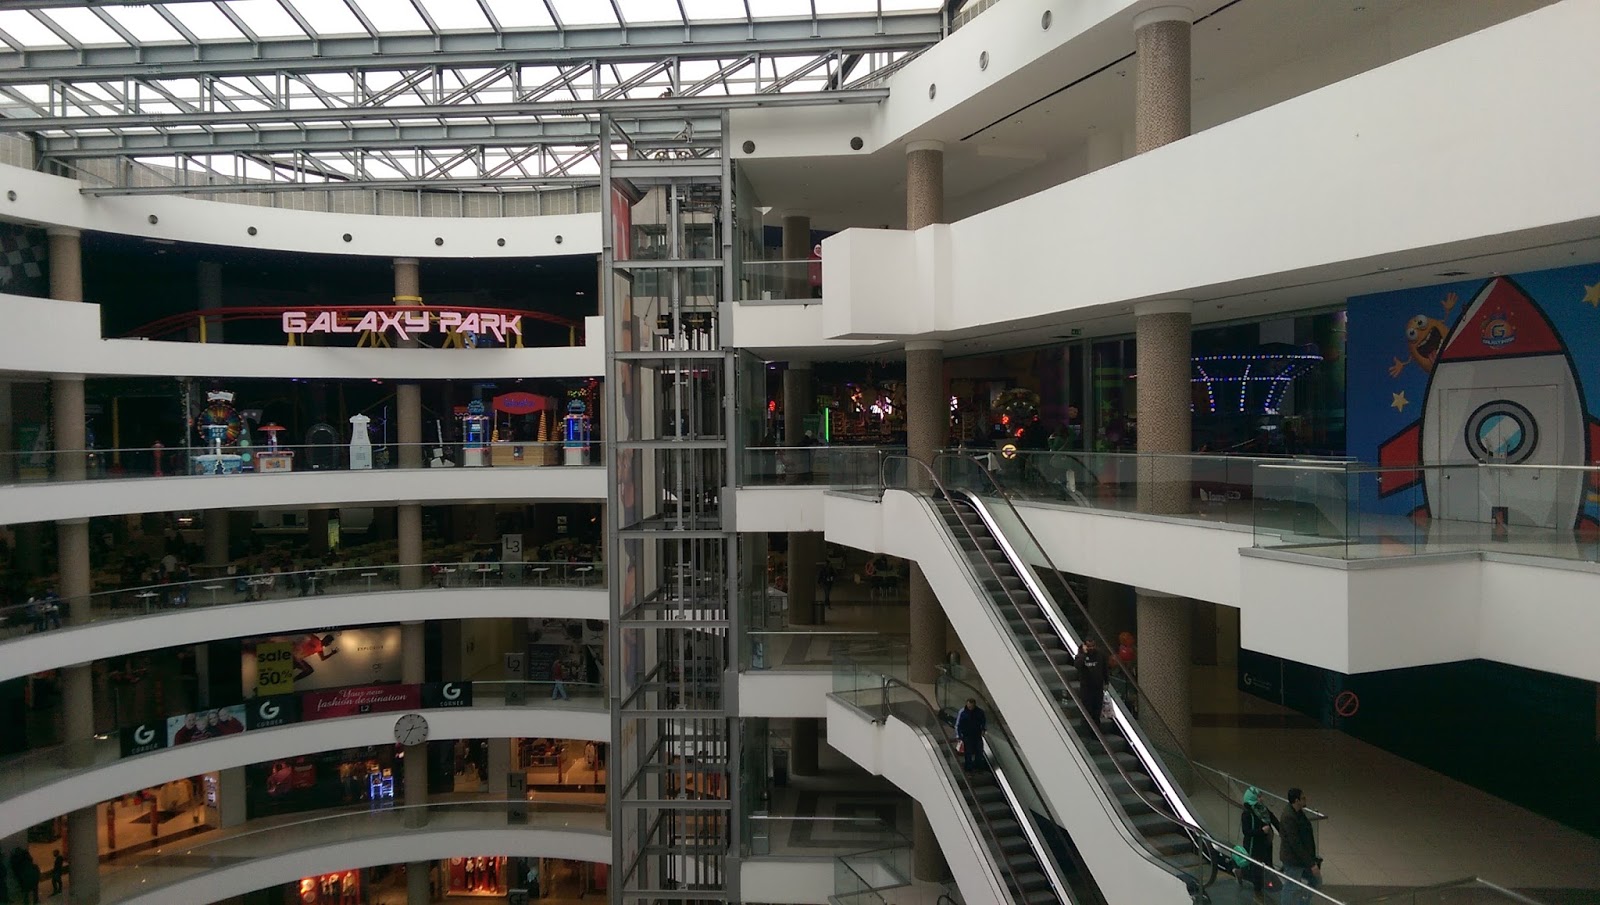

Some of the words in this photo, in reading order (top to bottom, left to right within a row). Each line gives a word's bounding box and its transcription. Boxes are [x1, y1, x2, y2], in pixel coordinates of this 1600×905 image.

[283, 311, 430, 341] GALAXY
[440, 311, 522, 342] PARK
[1491, 324, 1505, 338] G
[506, 537, 520, 552] L3
[258, 650, 291, 662] sale
[507, 656, 520, 671] L2
[259, 671, 292, 685] 50%
[339, 689, 364, 698] Your
[443, 682, 461, 700] G
[259, 701, 280, 719] G
[317, 698, 352, 712] fashion
[354, 694, 406, 705] destination
[134, 724, 155, 745] G
[510, 775, 522, 790] L1
